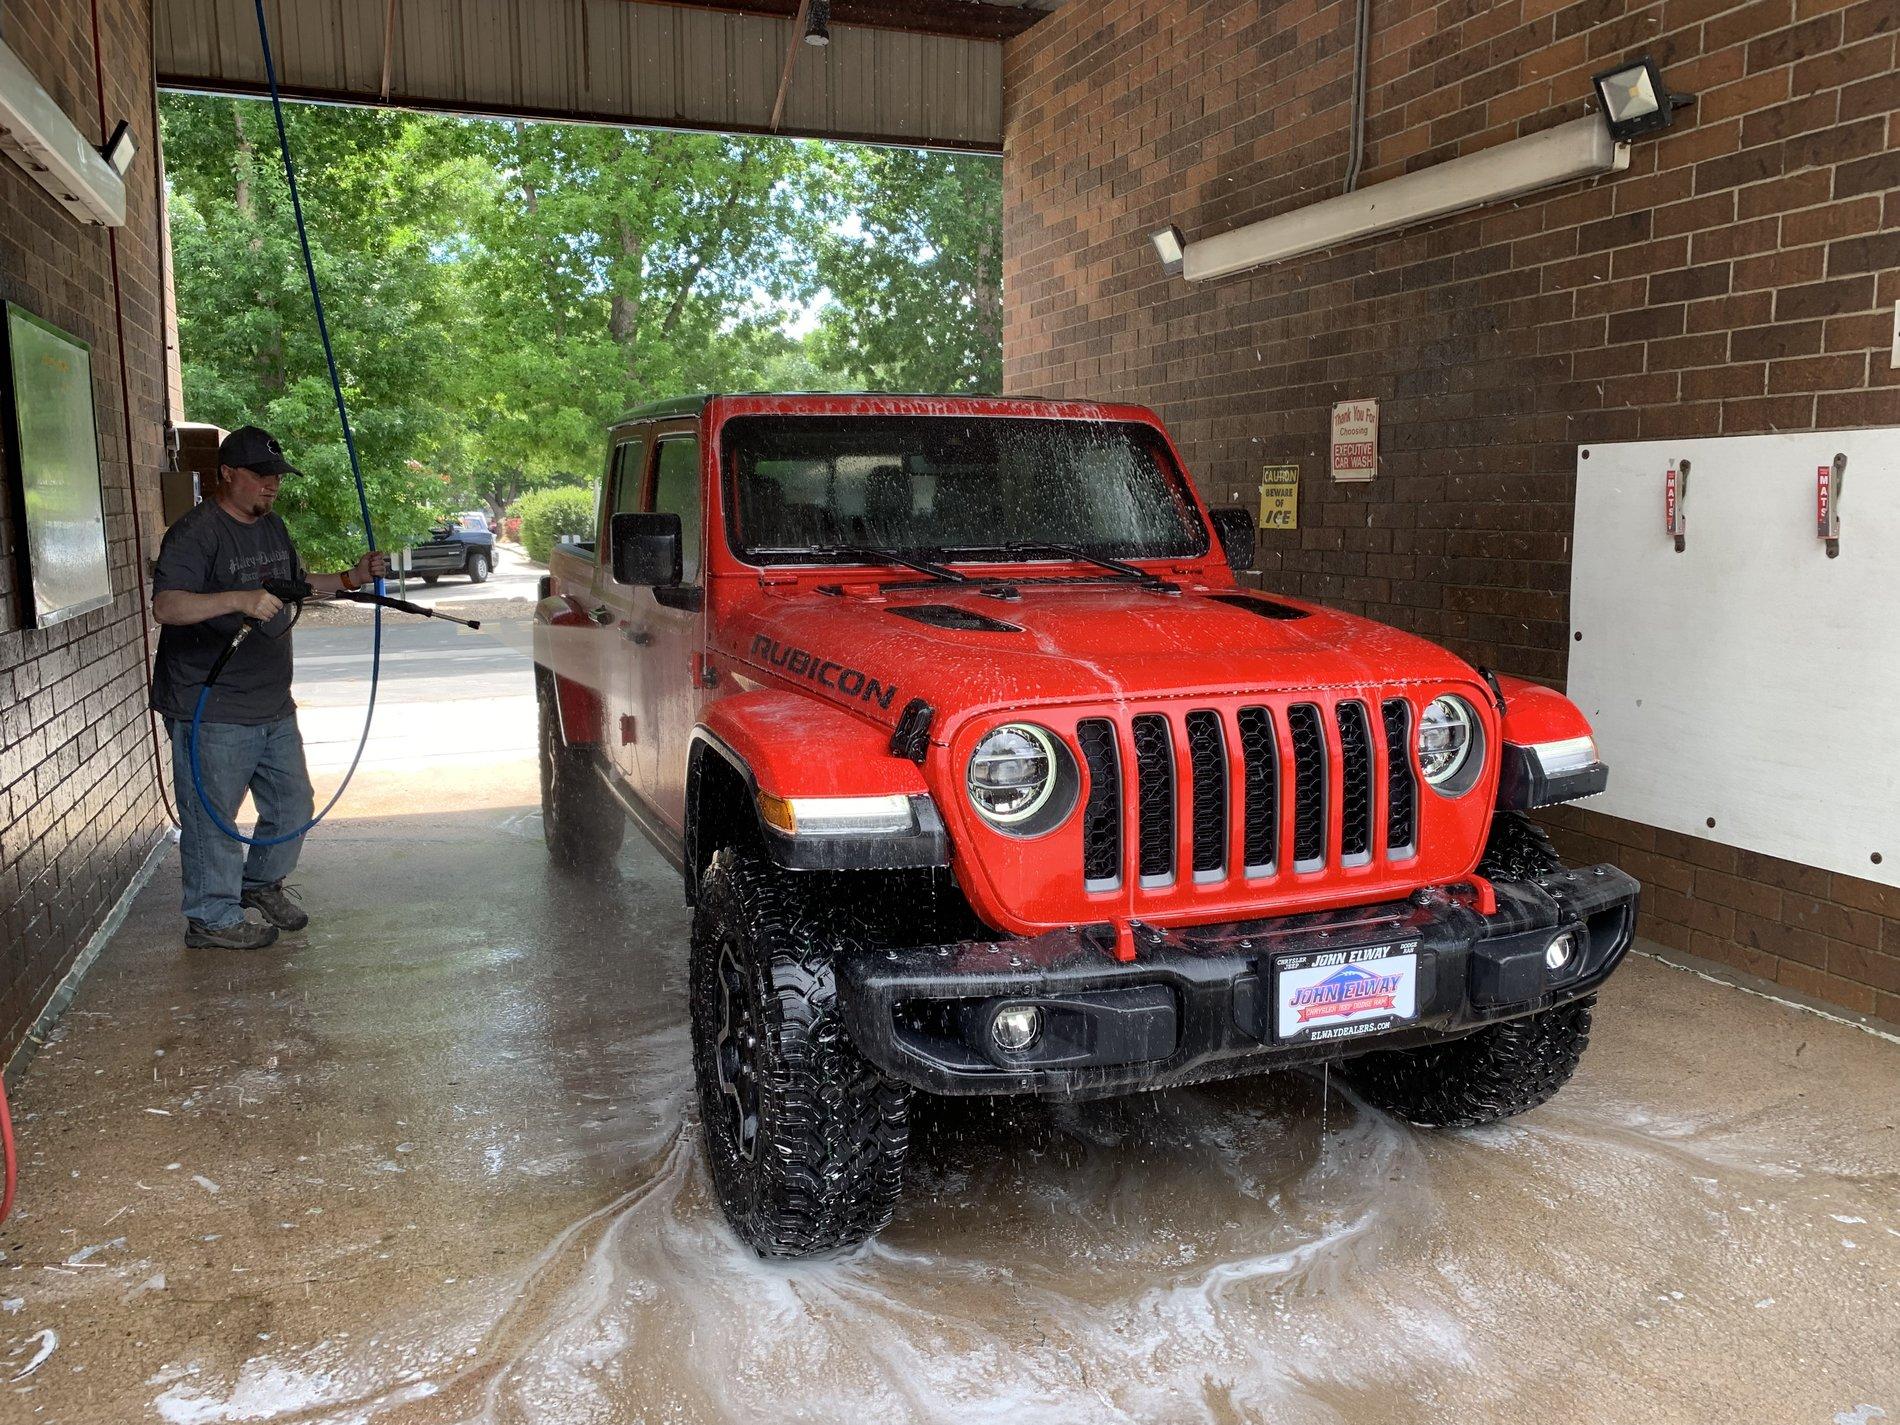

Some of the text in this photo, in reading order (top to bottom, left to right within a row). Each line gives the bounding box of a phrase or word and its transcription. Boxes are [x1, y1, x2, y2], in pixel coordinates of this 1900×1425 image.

[1335, 405, 1376, 426] Thank You For
[1340, 427, 1368, 436] Choosing
[1335, 444, 1372, 456] EXECUTIVE
[1335, 456, 1372, 468] CAR WASH
[1266, 488, 1293, 497] BEWARE
[1667, 479, 1675, 516] MATS
[1820, 475, 1829, 517] MATS
[1275, 499, 1284, 508] OF
[1266, 510, 1291, 524] ICE
[751, 633, 898, 710] RUBICON
[1277, 957, 1307, 965] CHRYSLER
[1311, 946, 1391, 967] JOHN ELWAY
[1289, 973, 1404, 1008] JOHN ELWAY
[1306, 1007, 1337, 1017] CHRYSLER
[1311, 1021, 1390, 1040] ELWAYDEALERS.COM
